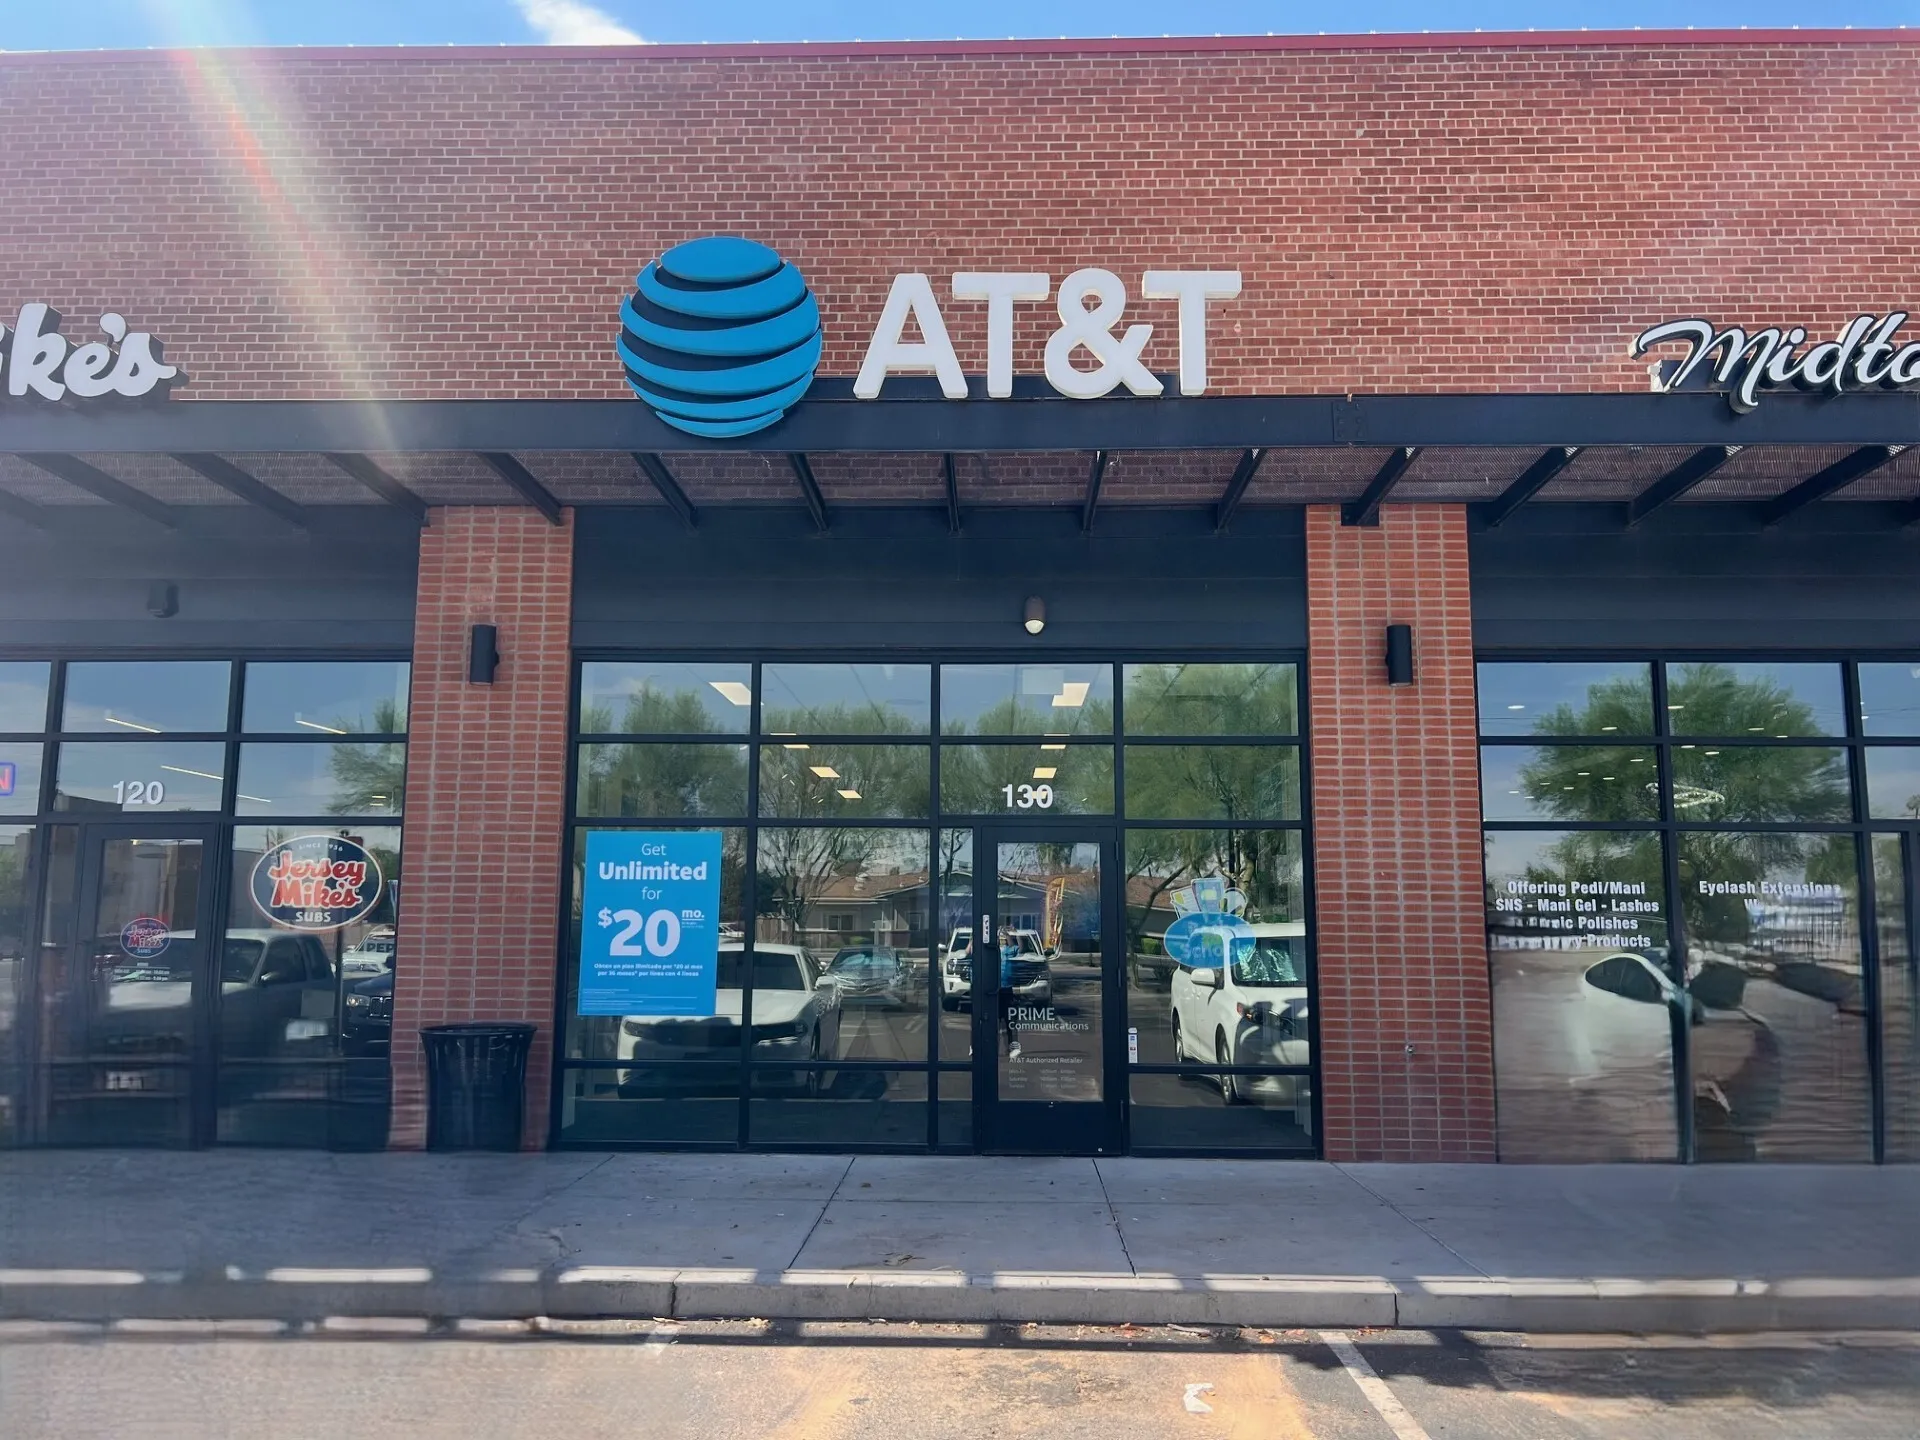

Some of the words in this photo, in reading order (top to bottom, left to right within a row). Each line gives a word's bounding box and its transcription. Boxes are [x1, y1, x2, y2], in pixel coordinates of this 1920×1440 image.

[853, 268, 1242, 399] AT&T
[0, 303, 177, 401] ke's
[113, 780, 164, 805] 120
[1002, 784, 1054, 808] 130
[641, 843, 667, 856] Get
[267, 850, 366, 886] Jersey
[599, 861, 707, 880] Unlimited
[270, 879, 363, 908] Mike's
[641, 886, 662, 900] for
[1507, 881, 1567, 897] Offering
[1571, 881, 1646, 895] Pedi/Mani
[1699, 881, 1756, 897] Eyelash
[1496, 899, 1523, 912] SNS
[1538, 899, 1571, 912] Mani
[1575, 899, 1597, 912] Gel
[1612, 899, 1660, 912] Lashes
[295, 911, 331, 922] SUBS
[1578, 916, 1639, 930] Polishes
[598, 907, 681, 957] $20
[682, 910, 705, 919] mo.
[1587, 933, 1651, 948] Products
[1008, 1007, 1055, 1020] PRIME
[1008, 1021, 1089, 1030] Communications
